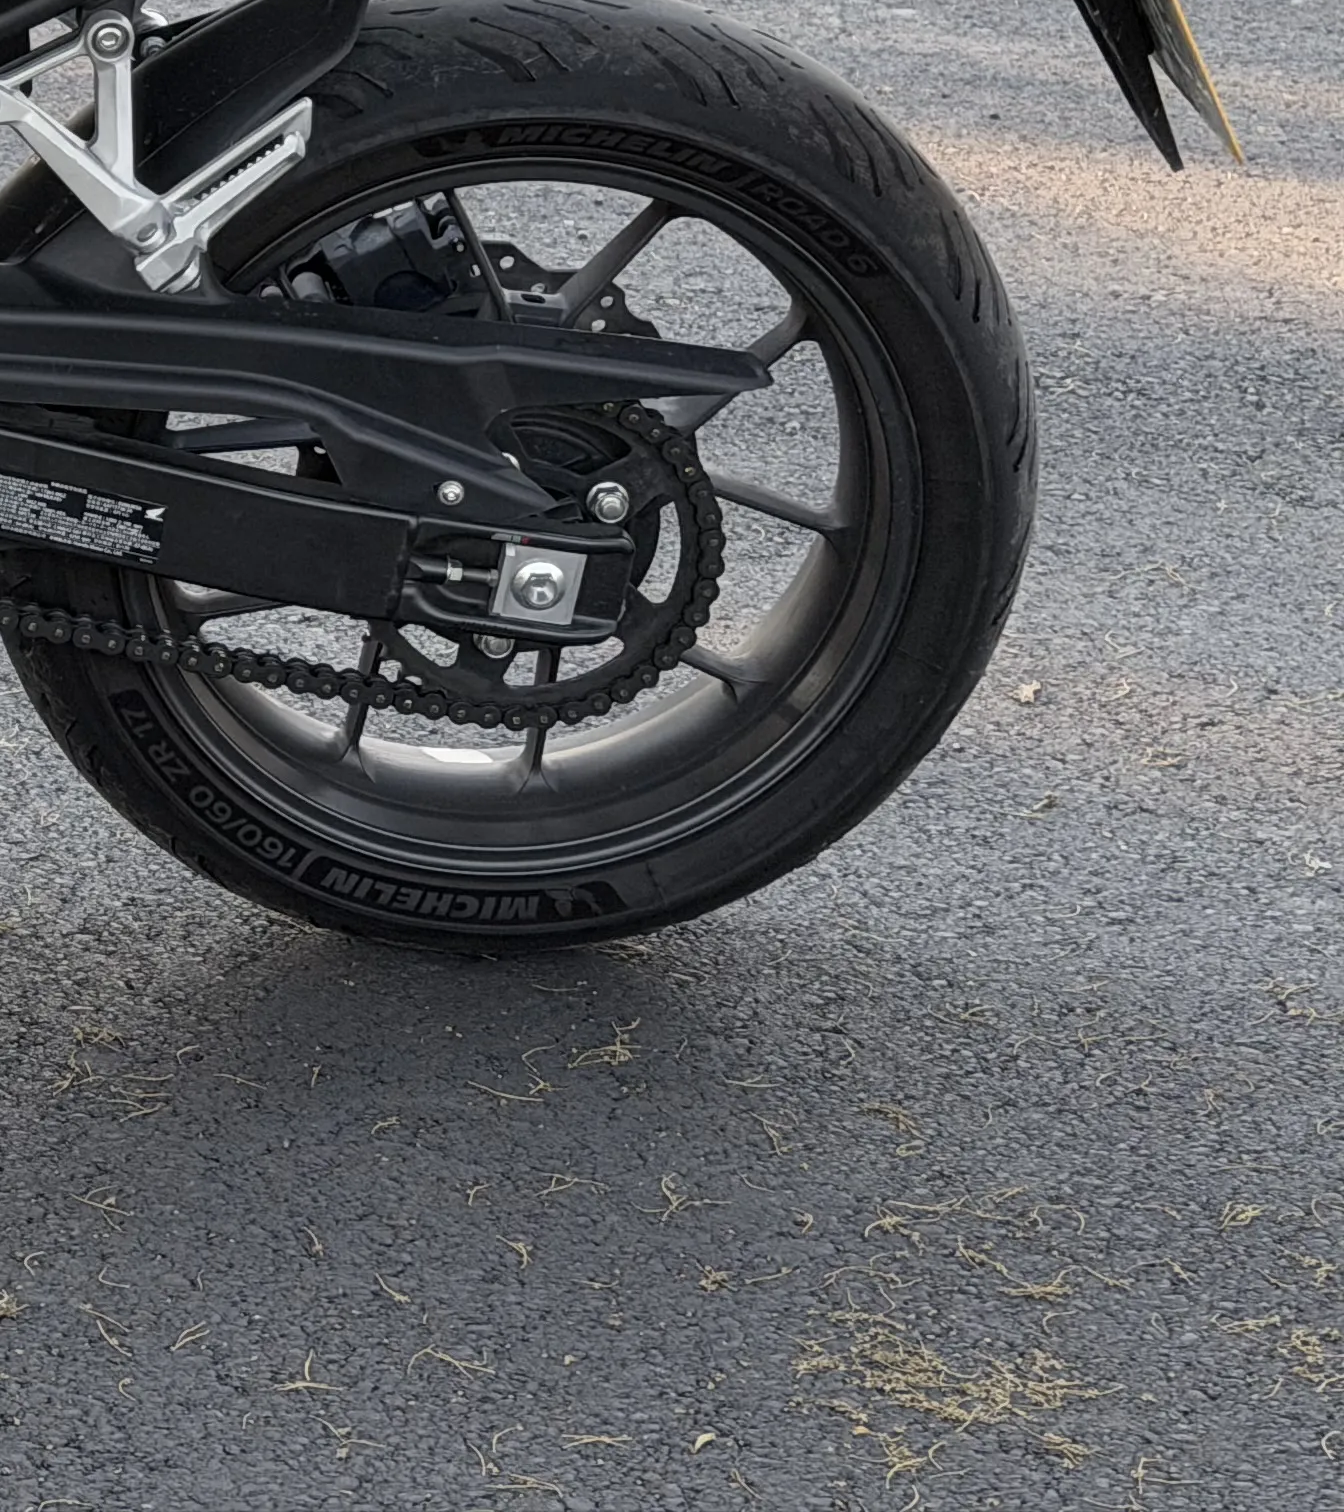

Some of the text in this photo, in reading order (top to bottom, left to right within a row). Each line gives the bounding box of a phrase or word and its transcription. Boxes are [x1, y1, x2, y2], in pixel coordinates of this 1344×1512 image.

[497, 124, 881, 279] MICHELIN ROAD 6
[115, 707, 300, 870] 160/60 ZR 17
[320, 865, 542, 923] MICHELIN
